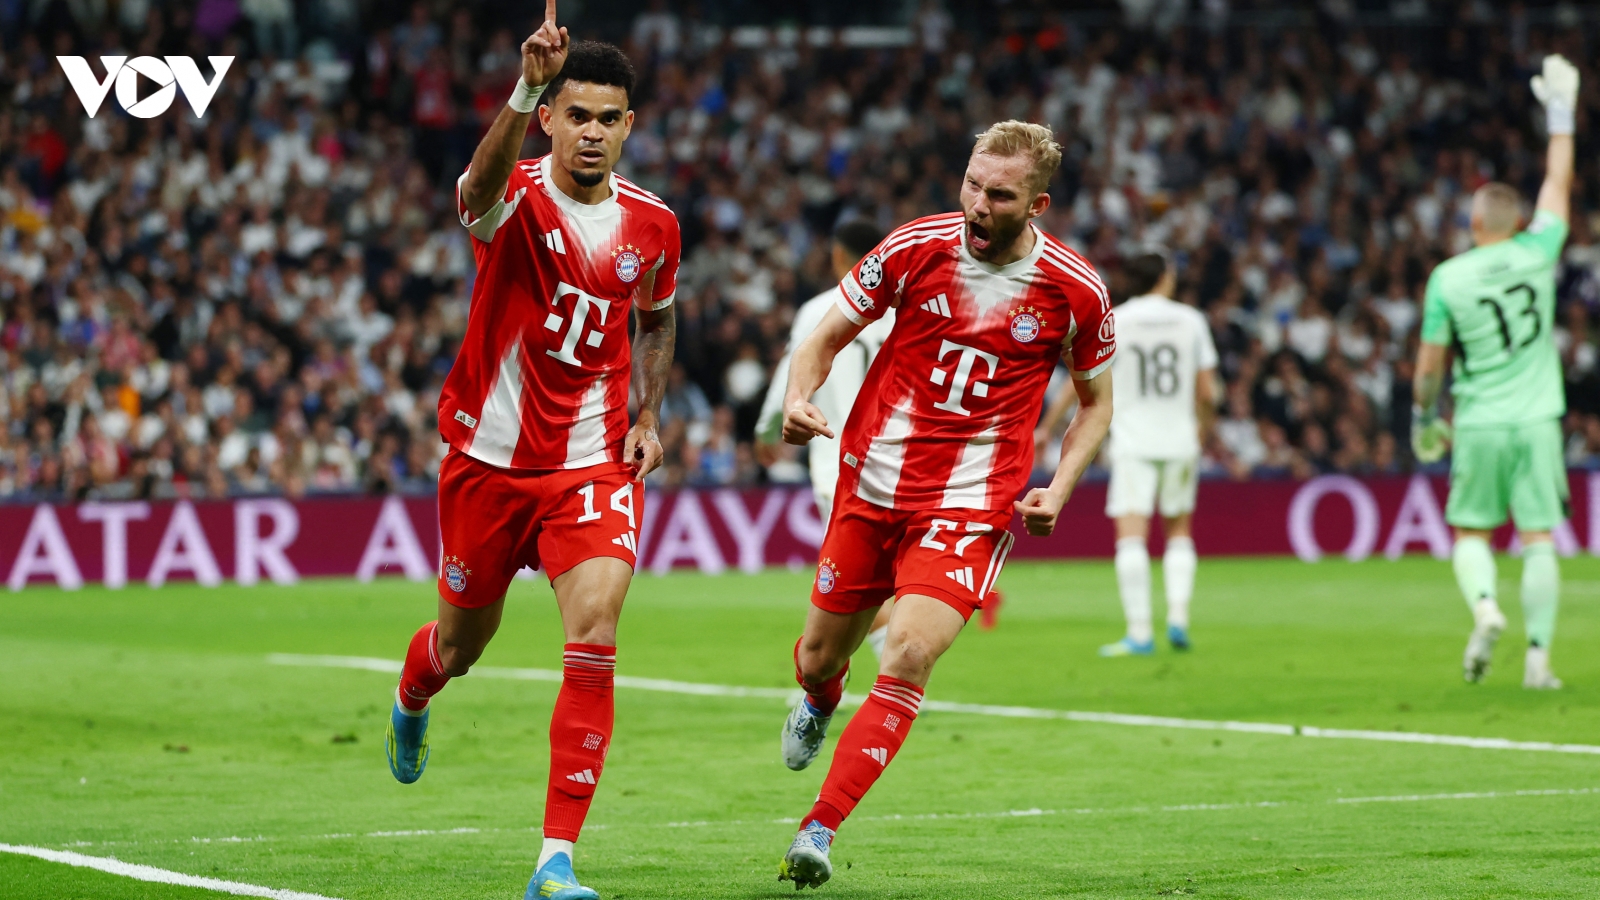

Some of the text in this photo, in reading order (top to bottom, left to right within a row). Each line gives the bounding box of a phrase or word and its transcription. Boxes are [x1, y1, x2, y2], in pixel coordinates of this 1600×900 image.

[544, 281, 611, 367] T
[1478, 282, 1541, 352] 13
[930, 339, 999, 416] T
[1127, 342, 1180, 399] 18
[577, 481, 637, 530] 14
[919, 519, 994, 557] 27
